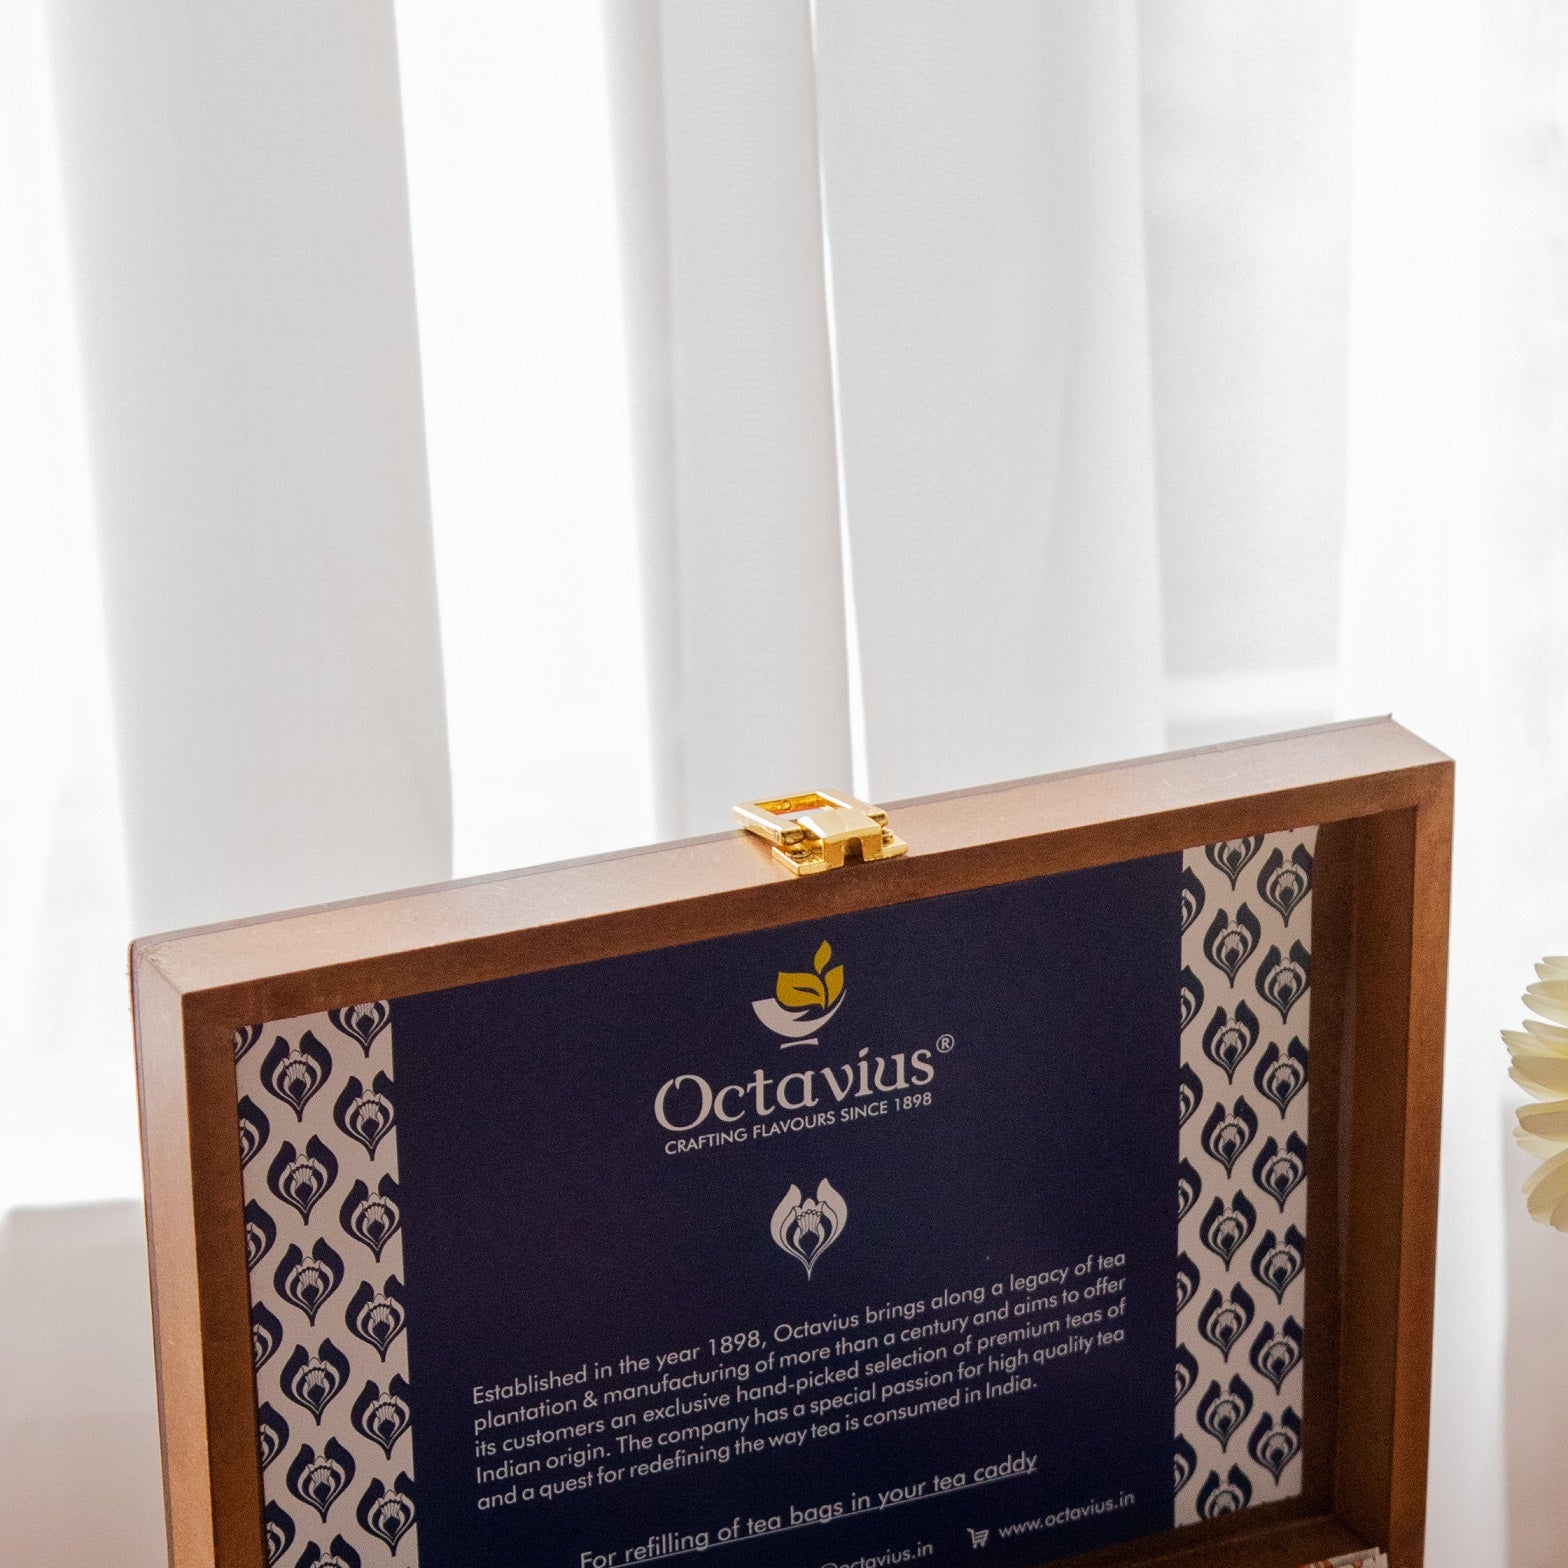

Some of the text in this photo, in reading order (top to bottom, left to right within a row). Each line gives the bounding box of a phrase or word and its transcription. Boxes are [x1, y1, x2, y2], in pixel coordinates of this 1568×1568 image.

[664, 1091, 932, 1155] CRAFTING FLAVOURS SINCE 1898
[472, 1250, 1126, 1405] Established in the year 1898, Octavius brings along a legacy of tea
[474, 1277, 1126, 1436] plantation & manufacturing of more than a century and aims to offer
[474, 1297, 1126, 1458] its customers an exclusive hand-picked selection of premium teas of
[476, 1327, 1125, 1484] Indian origin. The company has a special passion for high quality tea
[477, 1375, 1037, 1511] and a quest for redefining the way tea is consumed in India.
[625, 1531, 709, 1562] refilling
[717, 1518, 741, 1542] of
[747, 1514, 782, 1535] tea
[790, 1501, 843, 1526] bags
[851, 1493, 871, 1512] in
[878, 1480, 927, 1510] your
[933, 1472, 966, 1492] tea
[973, 1451, 1038, 1482] caddy
[998, 1491, 1135, 1539] www.octavius.in
